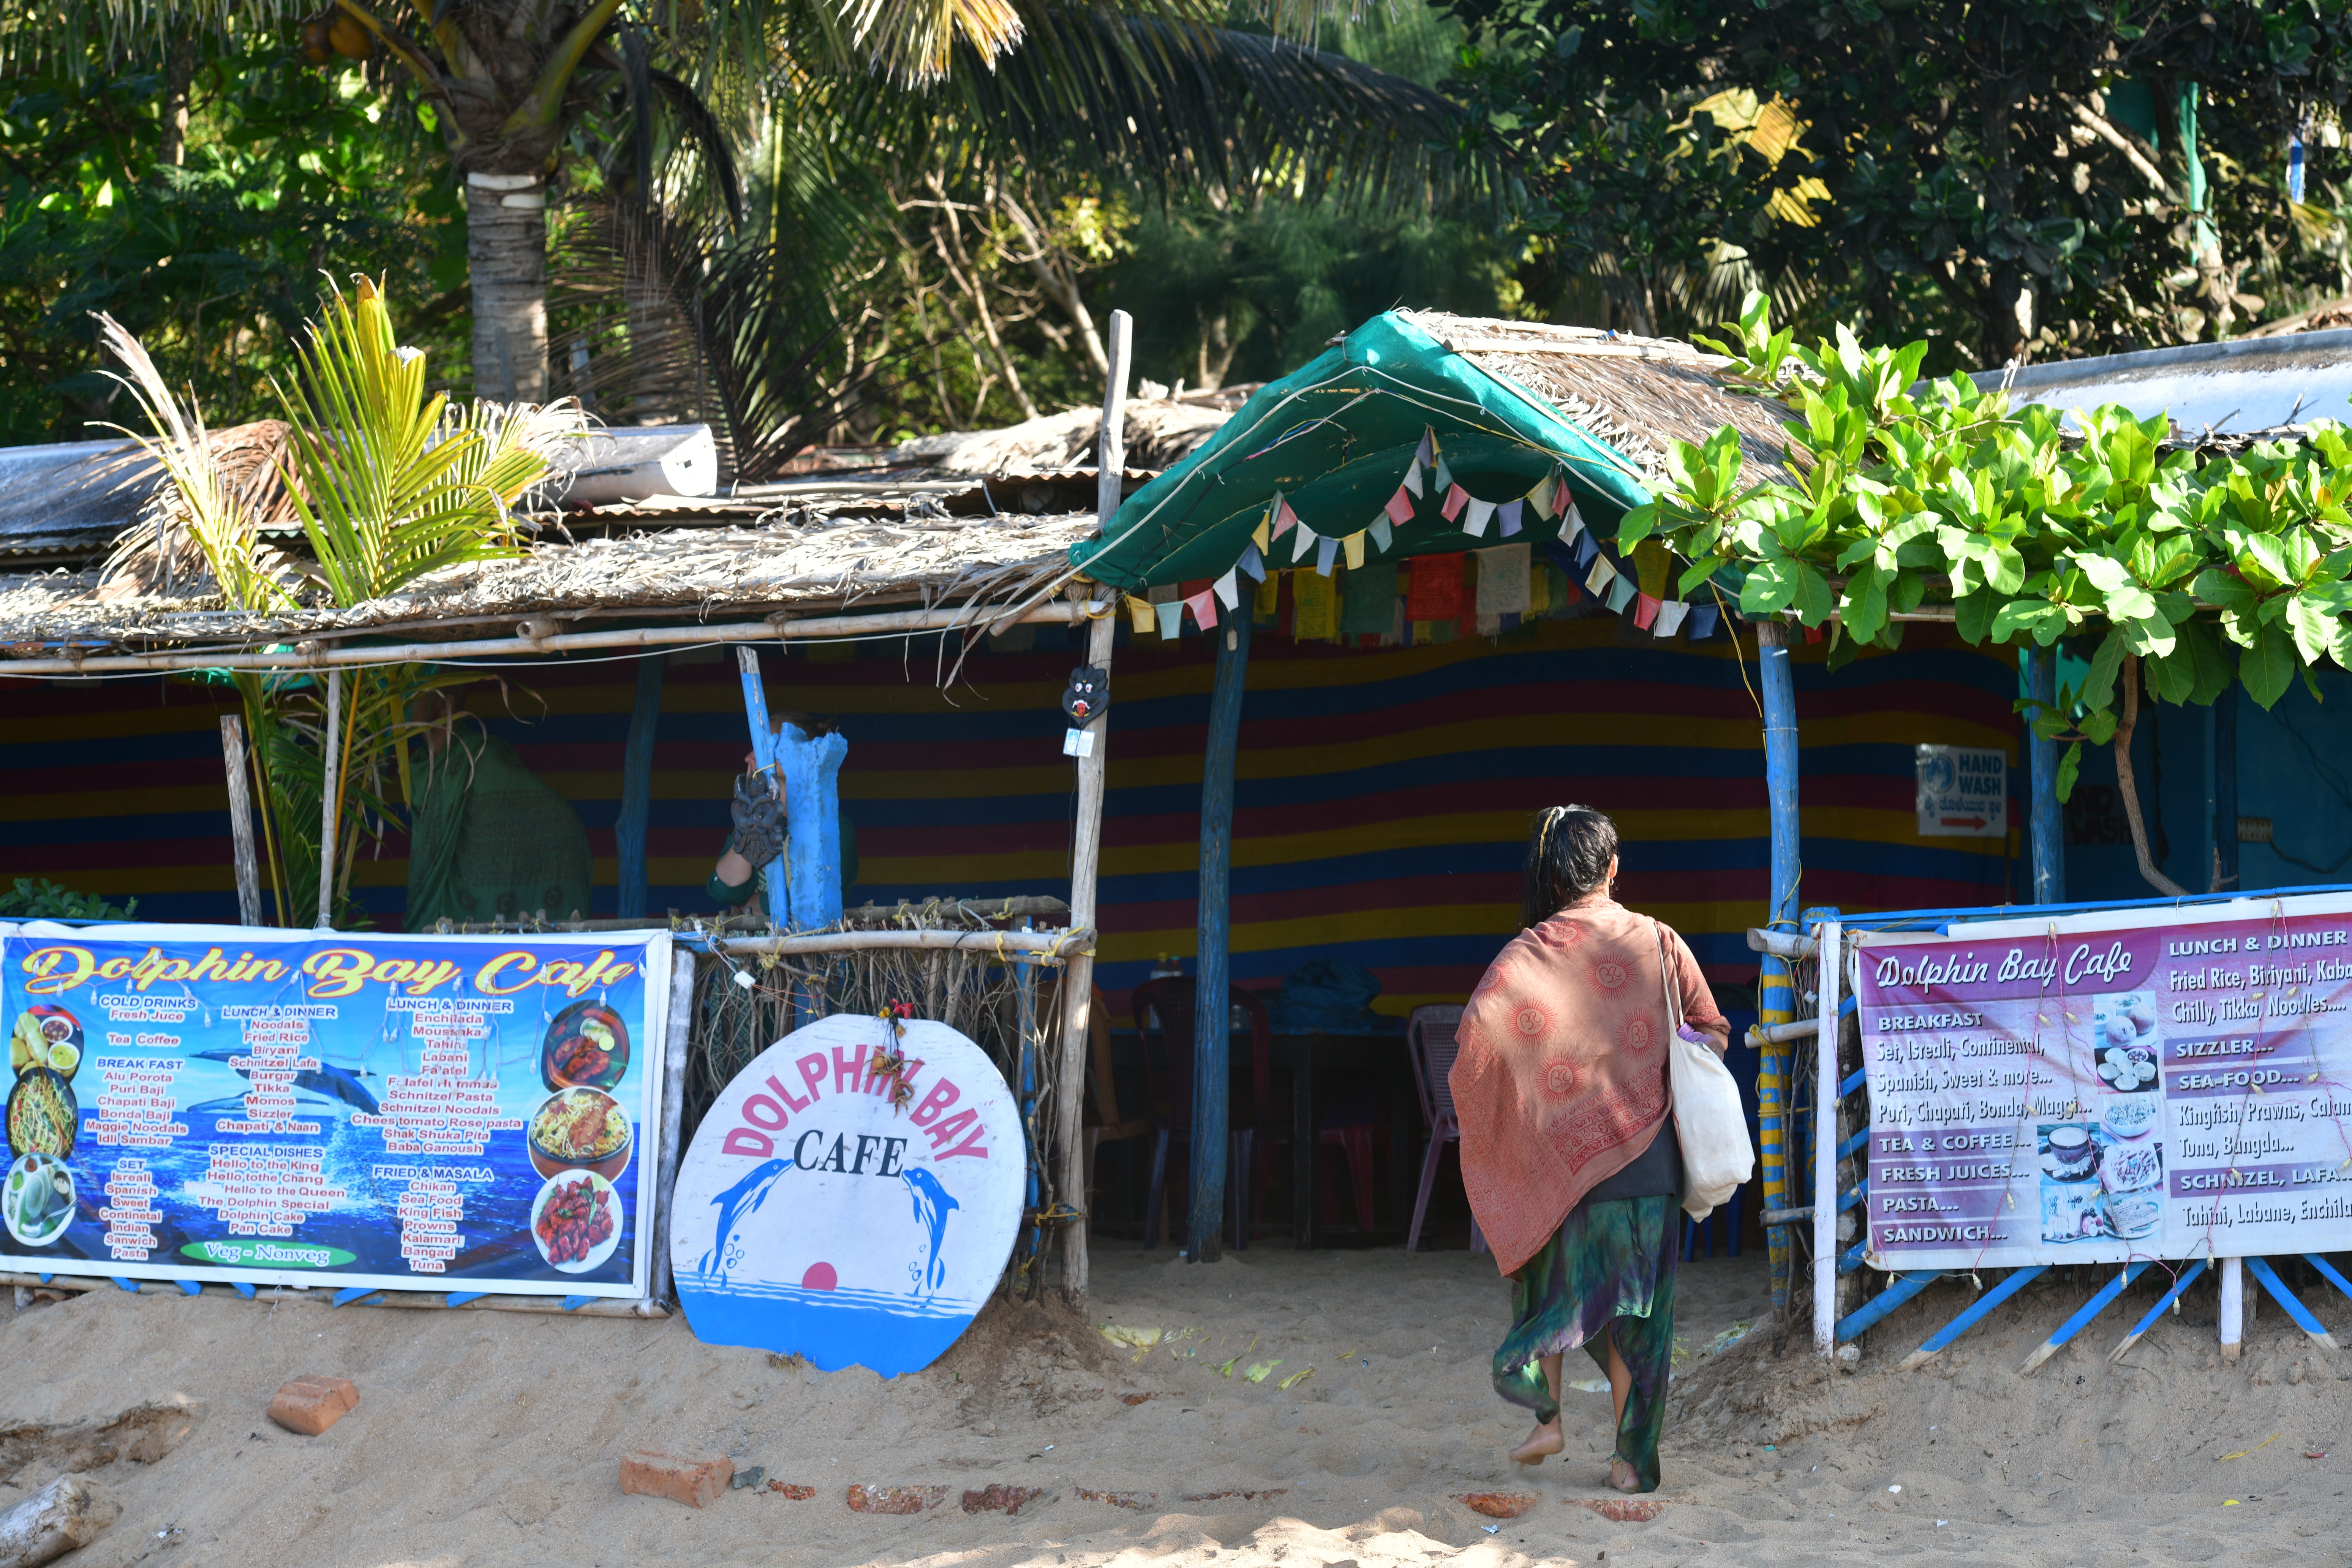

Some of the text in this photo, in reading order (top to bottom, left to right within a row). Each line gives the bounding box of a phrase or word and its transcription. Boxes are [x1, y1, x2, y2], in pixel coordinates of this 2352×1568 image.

[1959, 754, 2002, 774] HAND
[1958, 775, 2001, 795] WASH
[2170, 931, 2347, 956] LUNCH & DINNER
[21, 946, 636, 998] Dolphin Bay Cafe
[1876, 941, 2132, 993] Dolphin Bay Cafe
[2170, 968, 2206, 991] Fried
[2211, 967, 2246, 990] Rice,
[2250, 963, 2312, 989] Biriyani,
[101, 997, 196, 1008] COLD DRINKS
[389, 1000, 437, 1009] LUNCH
[457, 1002, 511, 1011] DINNER
[111, 1010, 183, 1020] Fresh Juce
[2173, 999, 2216, 1026] Chilly,
[415, 1014, 482, 1023] Enchilada
[1879, 1013, 1982, 1031] BREAKFAST
[109, 1035, 178, 1045] Tea Coffee
[254, 1046, 297, 1056] Biryani
[1876, 1033, 2045, 1064] Set, Isreali, Continental,
[2176, 1039, 2274, 1057] SIZZLER...
[98, 1059, 183, 1069] BREAK FAST
[230, 1058, 316, 1067] Schnitzel Lafa
[130, 1073, 172, 1082] Porota
[251, 1072, 295, 1081] Burgar
[1876, 1071, 1937, 1096] Spanish,
[1942, 1067, 1983, 1089] Sweet
[1988, 1068, 1998, 1085] &
[255, 1084, 289, 1092] Tikka
[388, 1078, 433, 1087] Flafel
[111, 1084, 164, 1096] Puri Baji
[247, 1097, 294, 1105] Momos
[389, 1091, 492, 1101] Schnitzel Pasta
[98, 1097, 174, 1109] Chapati Baji
[381, 1103, 499, 1114] Schnitzel Noodals
[721, 1044, 988, 1162] DOLPHIN BAY
[101, 1110, 170, 1121] Bonda Baji
[249, 1110, 292, 1118] Sizzler
[1879, 1103, 1911, 1125] Puri,
[1917, 1102, 1974, 1126] Chapati,
[2248, 1103, 2305, 1122] Prawns,
[86, 1121, 187, 1133] Maggie Noodals
[218, 1122, 269, 1132] Chapati
[352, 1115, 521, 1129] Chees tomato Rose pasta
[121, 1135, 170, 1144] Sambar
[384, 1129, 414, 1138] Shak
[419, 1130, 460, 1139] Shuka
[389, 1143, 481, 1153] Baba Ganoush
[1879, 1138, 1914, 1152] TEA
[1921, 1138, 1935, 1151] &
[2180, 1137, 2219, 1159] Tuna,
[210, 1146, 322, 1157] SPECIAL DISHES
[793, 1129, 907, 1178] CAFE
[213, 1159, 247, 1168] Hello
[267, 1161, 286, 1169] the
[291, 1162, 319, 1172] King
[112, 1173, 150, 1182] Isreali
[208, 1172, 241, 1181] Hello
[283, 1174, 323, 1185] Chang
[374, 1168, 492, 1179] FRIED & MASALA
[1881, 1167, 1940, 1182] FRESH
[107, 1185, 156, 1195] Spanish
[225, 1185, 256, 1194] Hello
[277, 1187, 295, 1195] the
[299, 1187, 345, 1197] Queen
[411, 1182, 454, 1191] Chikan
[113, 1198, 147, 1207] Sweet
[201, 1197, 329, 1209] The Dolphin Special
[401, 1195, 461, 1204] Sea Food
[1883, 1197, 1959, 1211] PASTA...
[101, 1210, 160, 1220] Continetal
[220, 1211, 303, 1221] Dolphin Cake
[399, 1208, 461, 1219] King Fish
[2184, 1206, 2233, 1228] Tahini,
[2238, 1202, 2296, 1224] Labane,
[113, 1223, 149, 1232] Indian
[259, 1225, 292, 1234] Cake
[405, 1221, 454, 1231] Prowns
[106, 1235, 156, 1245] Sanwich
[403, 1234, 460, 1244] Kalamari
[114, 1248, 146, 1258] Pasta
[206, 1244, 239, 1260] Veg
[257, 1246, 329, 1264] Nonveg
[404, 1247, 453, 1258] Bangad
[411, 1260, 443, 1269] Tuna
